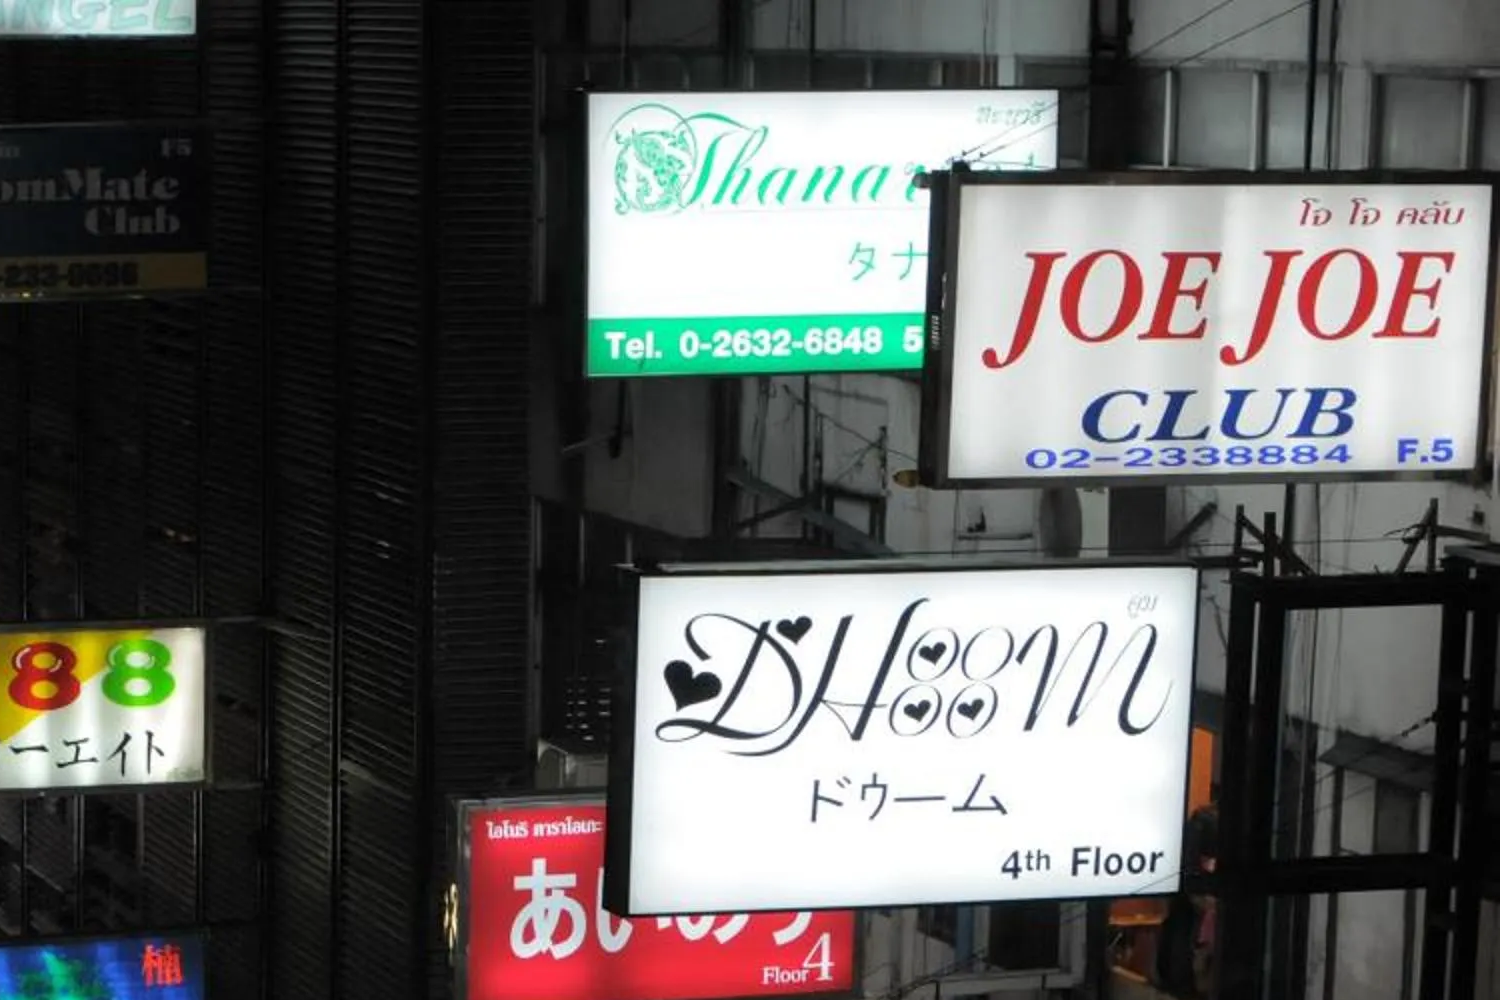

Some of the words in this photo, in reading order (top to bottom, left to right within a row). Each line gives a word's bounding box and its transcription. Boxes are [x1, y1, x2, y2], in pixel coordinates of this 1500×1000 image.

[84, 205, 181, 235] Club
[1299, 198, 1333, 227] โจ
[1349, 197, 1381, 226] โจ
[1396, 198, 1464, 226] คลับ
[981, 249, 1222, 369] JOE
[1219, 249, 1456, 366] JOE
[604, 330, 663, 361] Tel.
[679, 326, 884, 359] 0-2632-6848
[1082, 386, 1357, 443] CLUB
[1025, 443, 1352, 470] 02-2338884
[1397, 438, 1455, 464] F.5
[1001, 849, 1051, 880] 4th
[1070, 846, 1165, 878] Floor
[762, 965, 809, 985] Floor
[802, 932, 834, 982] 4
